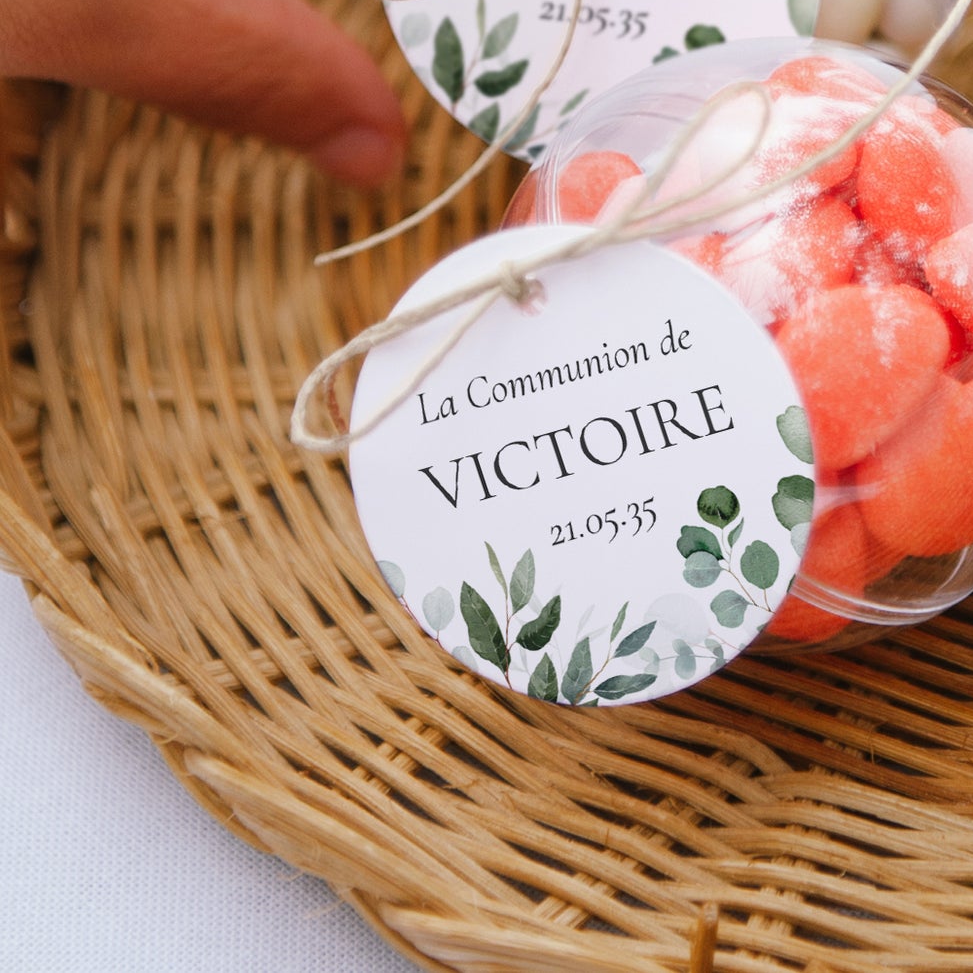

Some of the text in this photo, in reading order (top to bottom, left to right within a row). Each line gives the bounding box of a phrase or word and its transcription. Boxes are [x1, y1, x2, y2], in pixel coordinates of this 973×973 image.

[417, 319, 694, 426] La Communion de
[418, 384, 736, 510] VICTOIRE
[549, 497, 658, 546] 21.05.35
